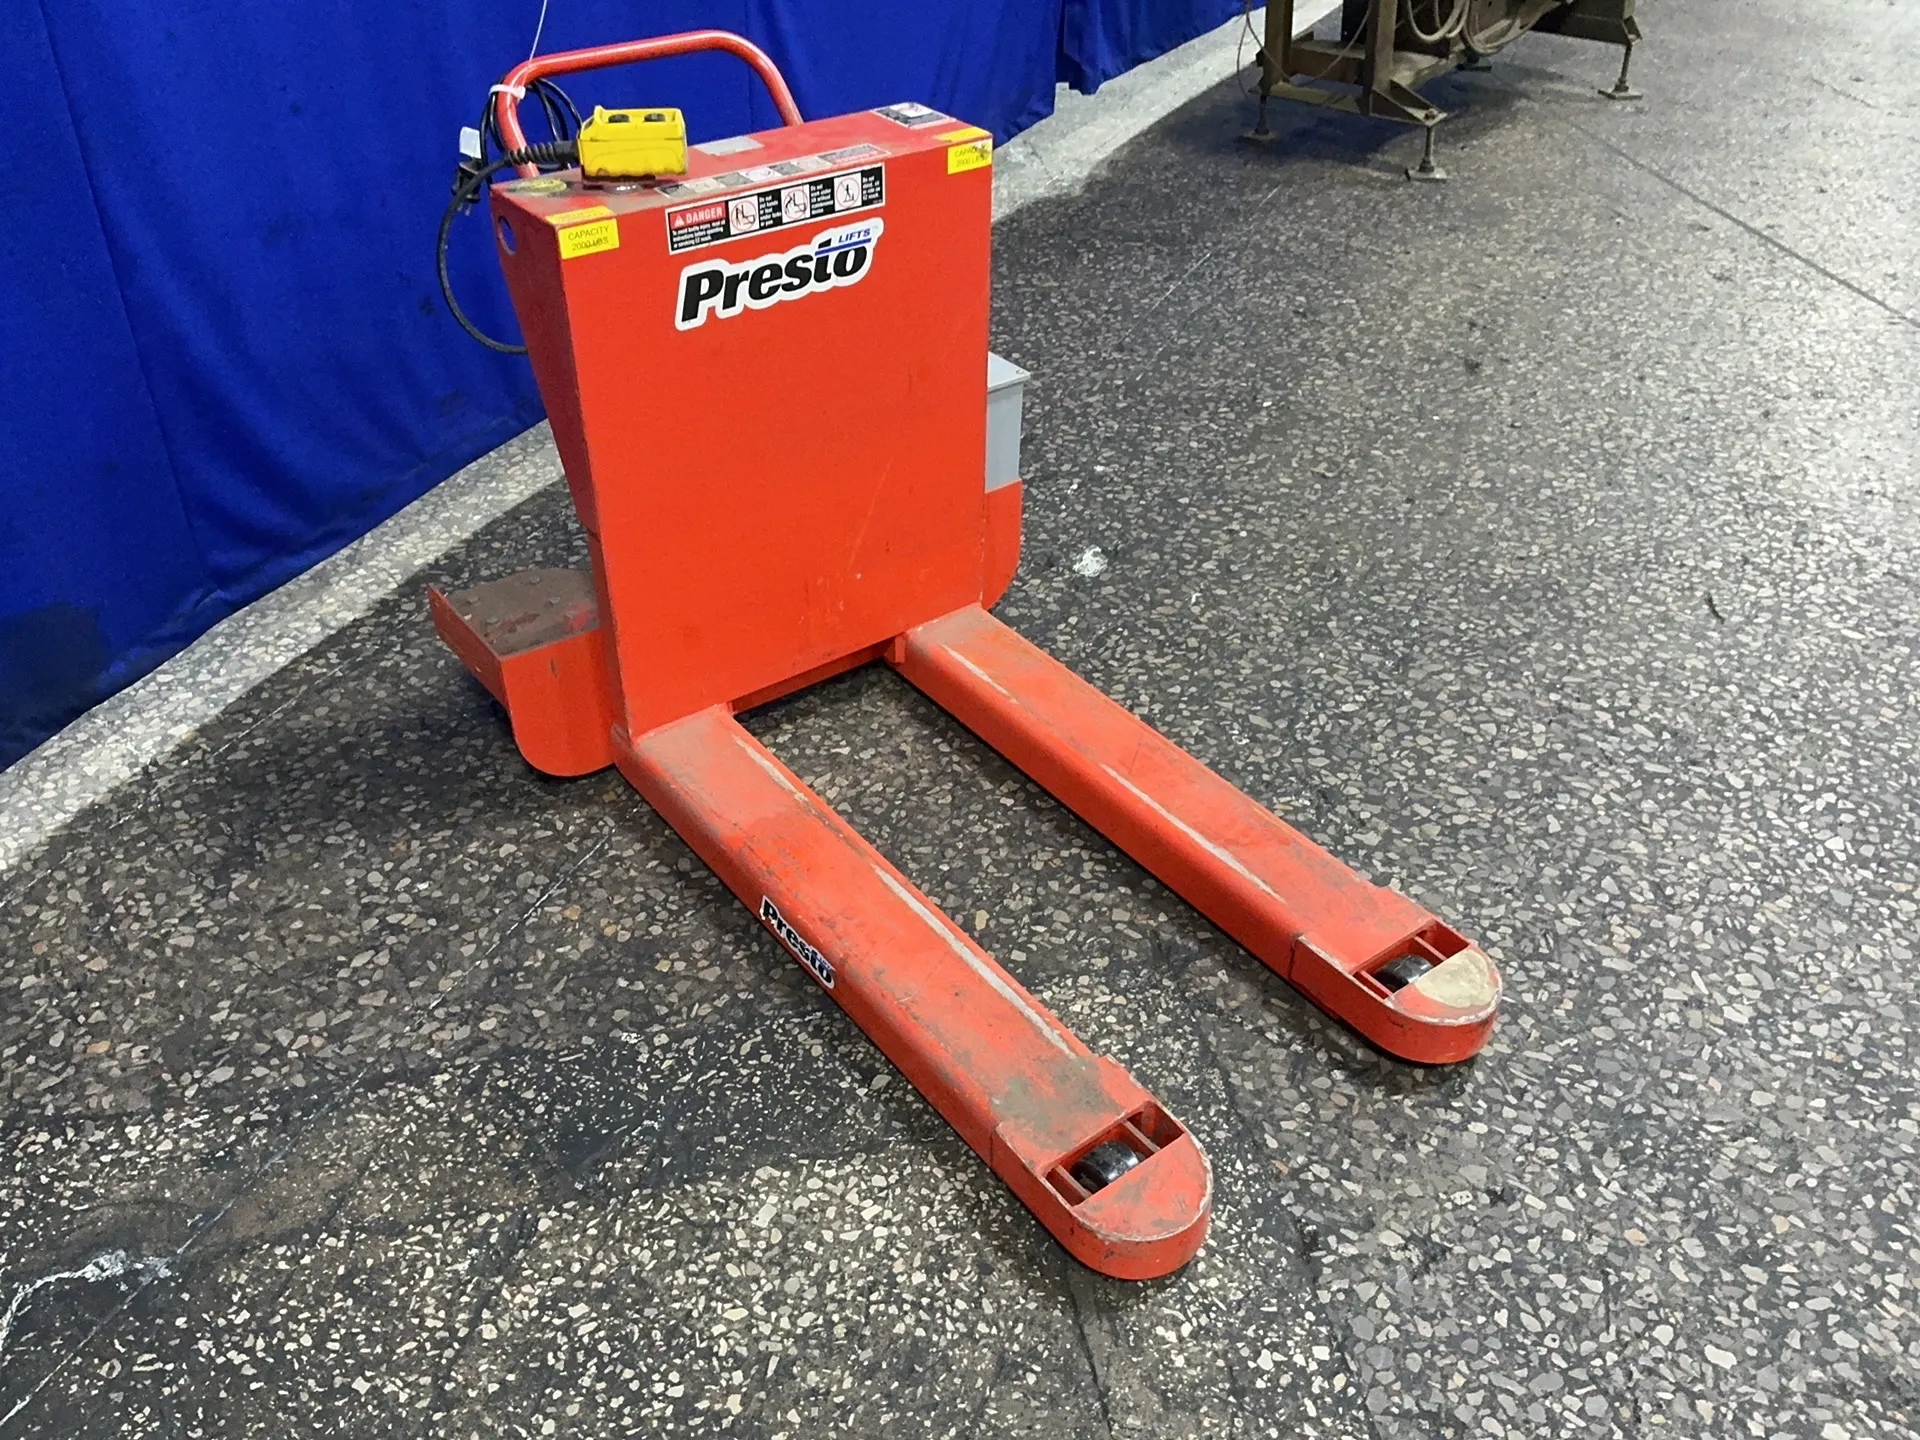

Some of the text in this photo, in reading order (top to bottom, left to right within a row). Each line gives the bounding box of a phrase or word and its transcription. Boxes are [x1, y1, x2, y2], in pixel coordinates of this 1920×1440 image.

[686, 206, 723, 224] DANGER
[568, 225, 610, 241] CAPACITY
[838, 227, 870, 244] LIFTS
[681, 237, 868, 323] Presto
[762, 897, 833, 984] Presto
